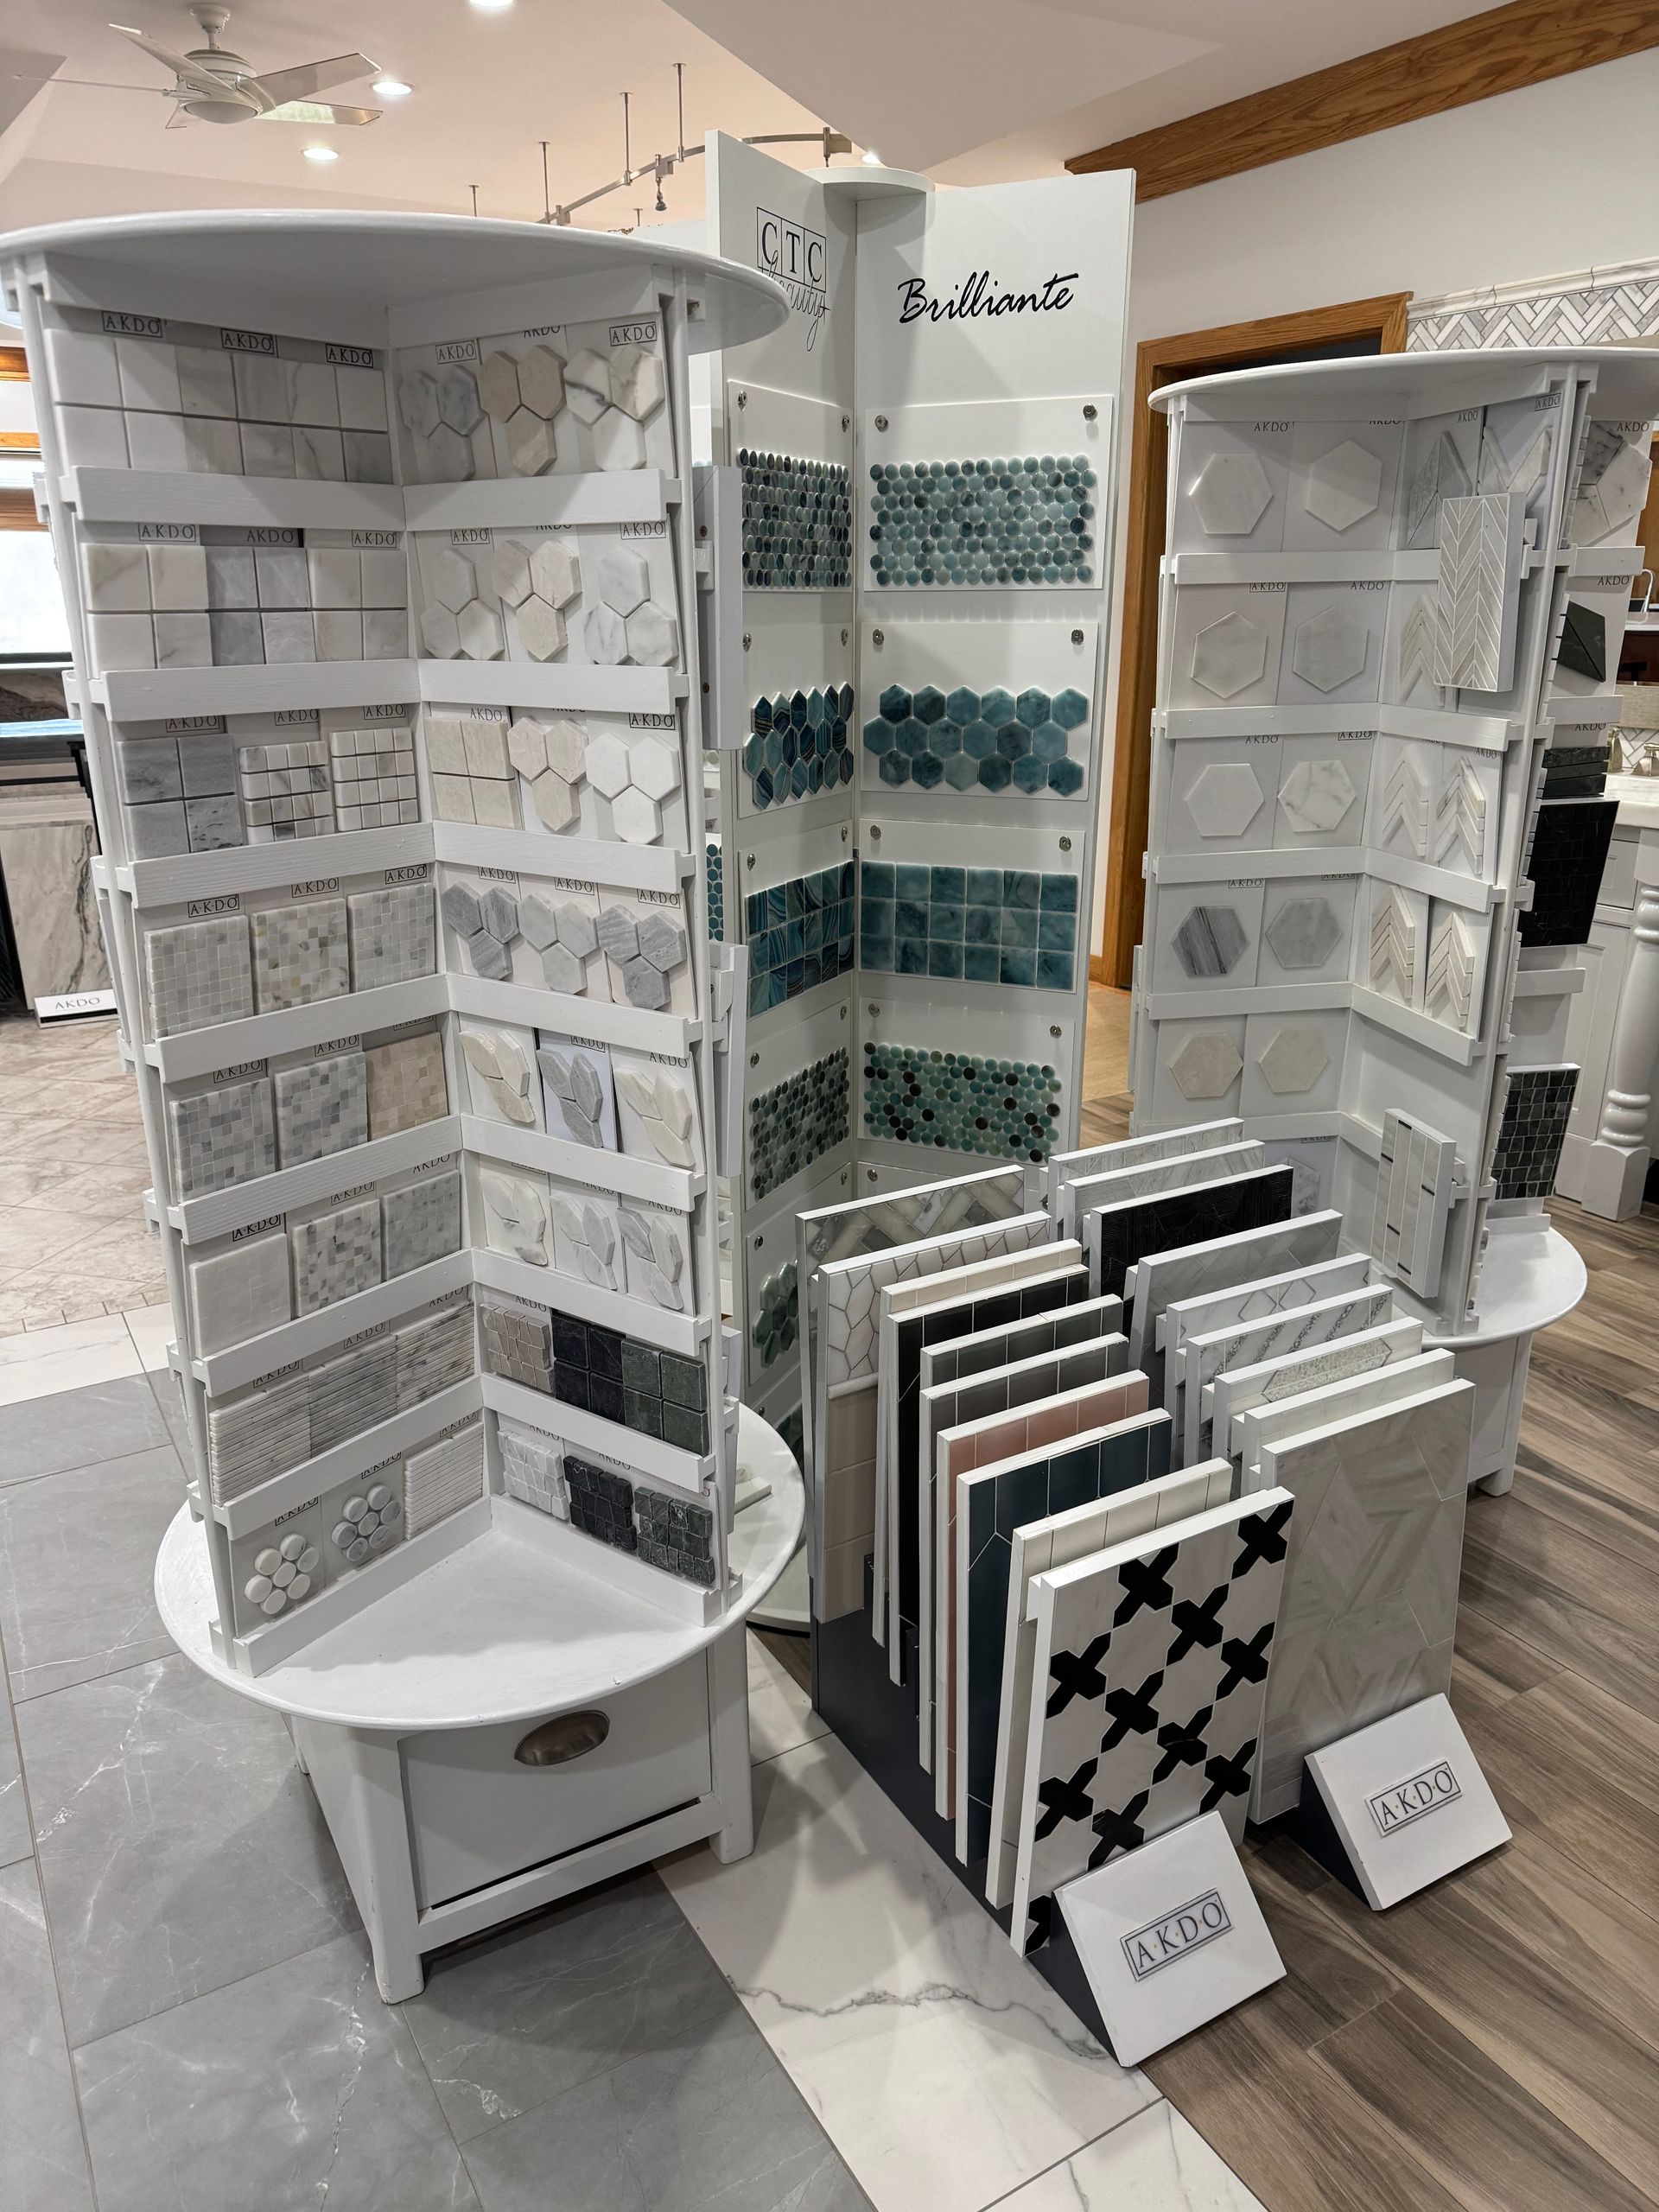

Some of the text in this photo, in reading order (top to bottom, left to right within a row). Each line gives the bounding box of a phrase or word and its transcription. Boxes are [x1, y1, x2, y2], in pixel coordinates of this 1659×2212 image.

[761, 221, 823, 283] CTC
[898, 270, 1079, 324] Brilliante
[106, 312, 160, 334] AKDO
[612, 323, 656, 343] AKDO
[225, 333, 272, 352] AKDO
[329, 348, 372, 365] AKDO
[439, 343, 474, 360] AKDO
[1536, 395, 1560, 409] AKDO
[1458, 410, 1478, 423] AKDO
[1254, 422, 1289, 432] AKDO
[1617, 422, 1649, 432] AKDO
[142, 524, 194, 539] AKDO
[247, 530, 294, 543] AKDO
[453, 530, 488, 543] AKDO
[623, 523, 664, 536] AKDO
[354, 532, 395, 546] AKDO
[1251, 582, 1285, 591] AKDO
[1351, 581, 1384, 591] AKDO
[1598, 575, 1630, 586] AKDO
[276, 709, 318, 722] AKDO
[365, 705, 404, 718] AKDO
[470, 708, 503, 721] AKDO
[168, 716, 218, 729] AKDO
[631, 714, 674, 728] AKDO
[1245, 734, 1279, 744] AKDO
[387, 865, 425, 881] AKDO
[480, 867, 514, 881] AKDO
[294, 879, 337, 894] AKDO
[556, 878, 594, 892] AKDO
[639, 891, 679, 906] AKDO
[190, 898, 238, 915] AKDO
[55, 997, 100, 1009] AKDO
[317, 1035, 357, 1053] AKDO
[650, 1052, 688, 1068] AKDO
[215, 1060, 261, 1079] AKDO
[334, 1182, 373, 1202] AKDO
[235, 1215, 279, 1238] AKDO
[1379, 1768, 1454, 1827] AKDO
[1138, 1899, 1224, 1968] AKDO
